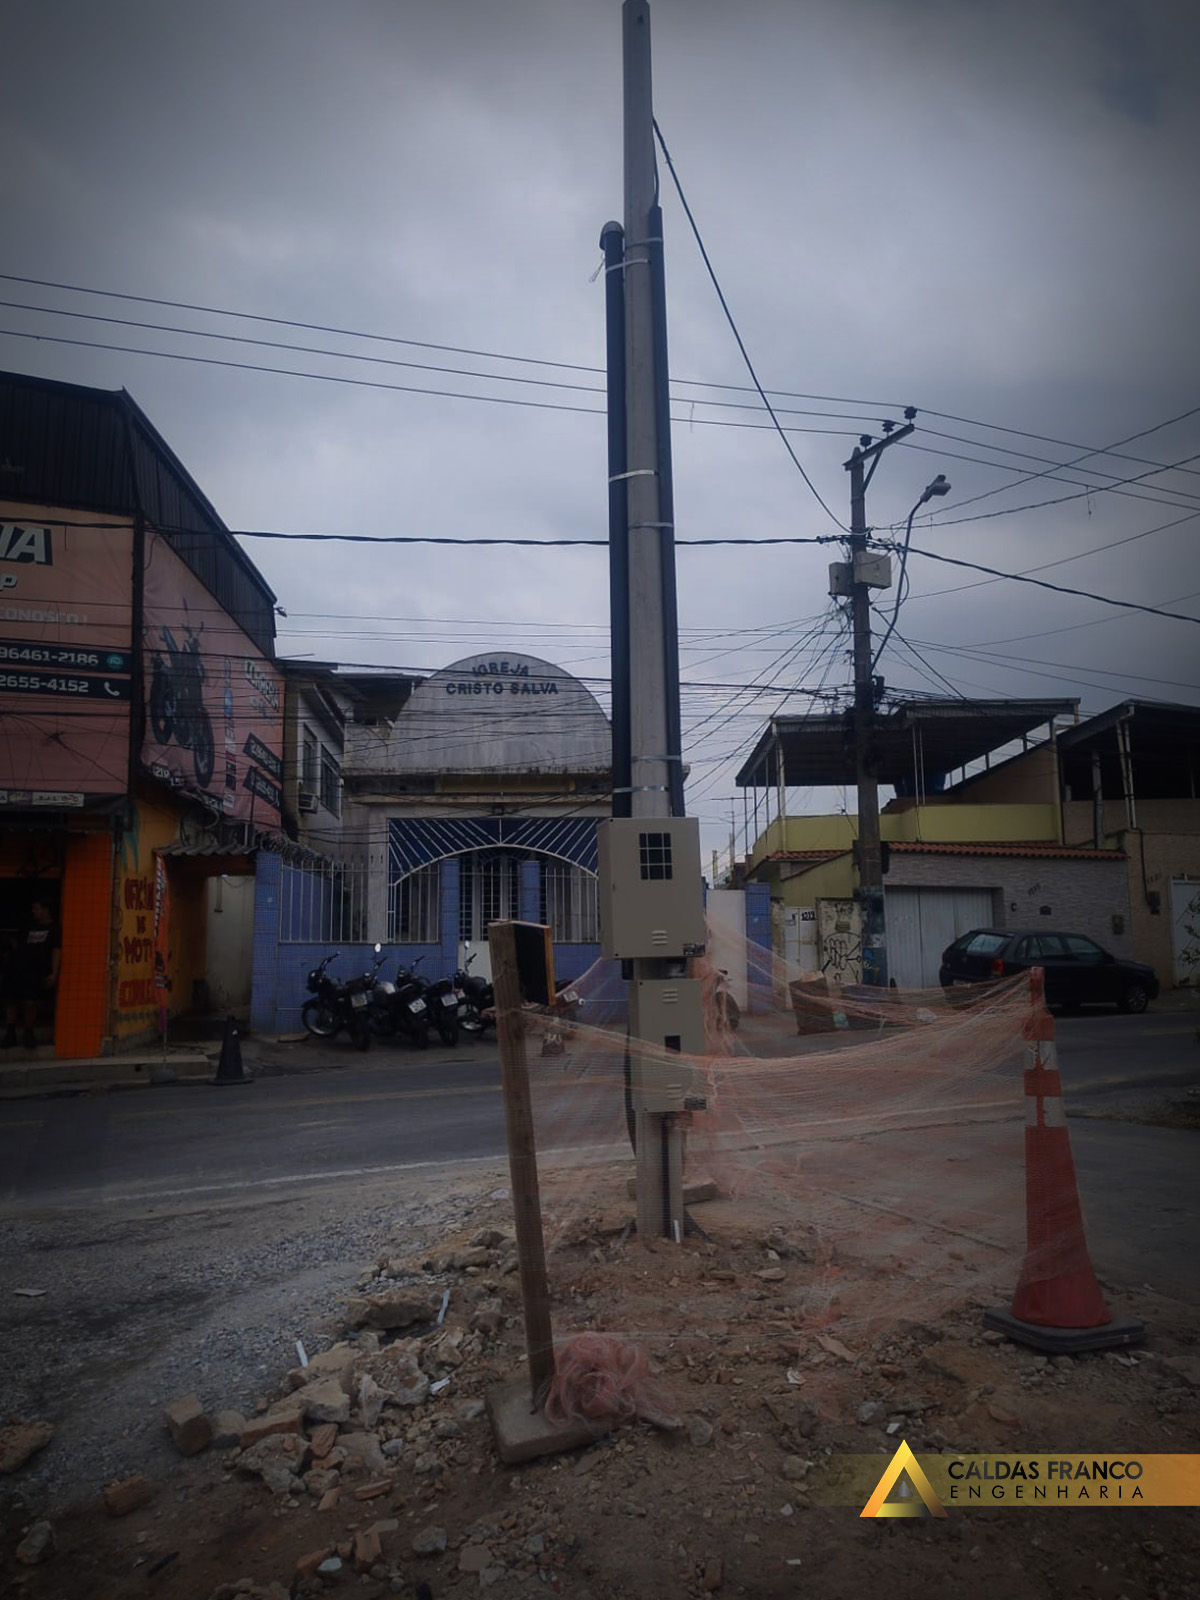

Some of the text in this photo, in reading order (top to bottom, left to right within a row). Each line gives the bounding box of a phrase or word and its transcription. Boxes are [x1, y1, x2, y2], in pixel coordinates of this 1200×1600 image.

[0, 646, 99, 665] 96461-2186
[472, 662, 529, 676] IGREJA
[0, 675, 89, 692] 2655-4152
[446, 682, 558, 695] CRISTO SALVA
